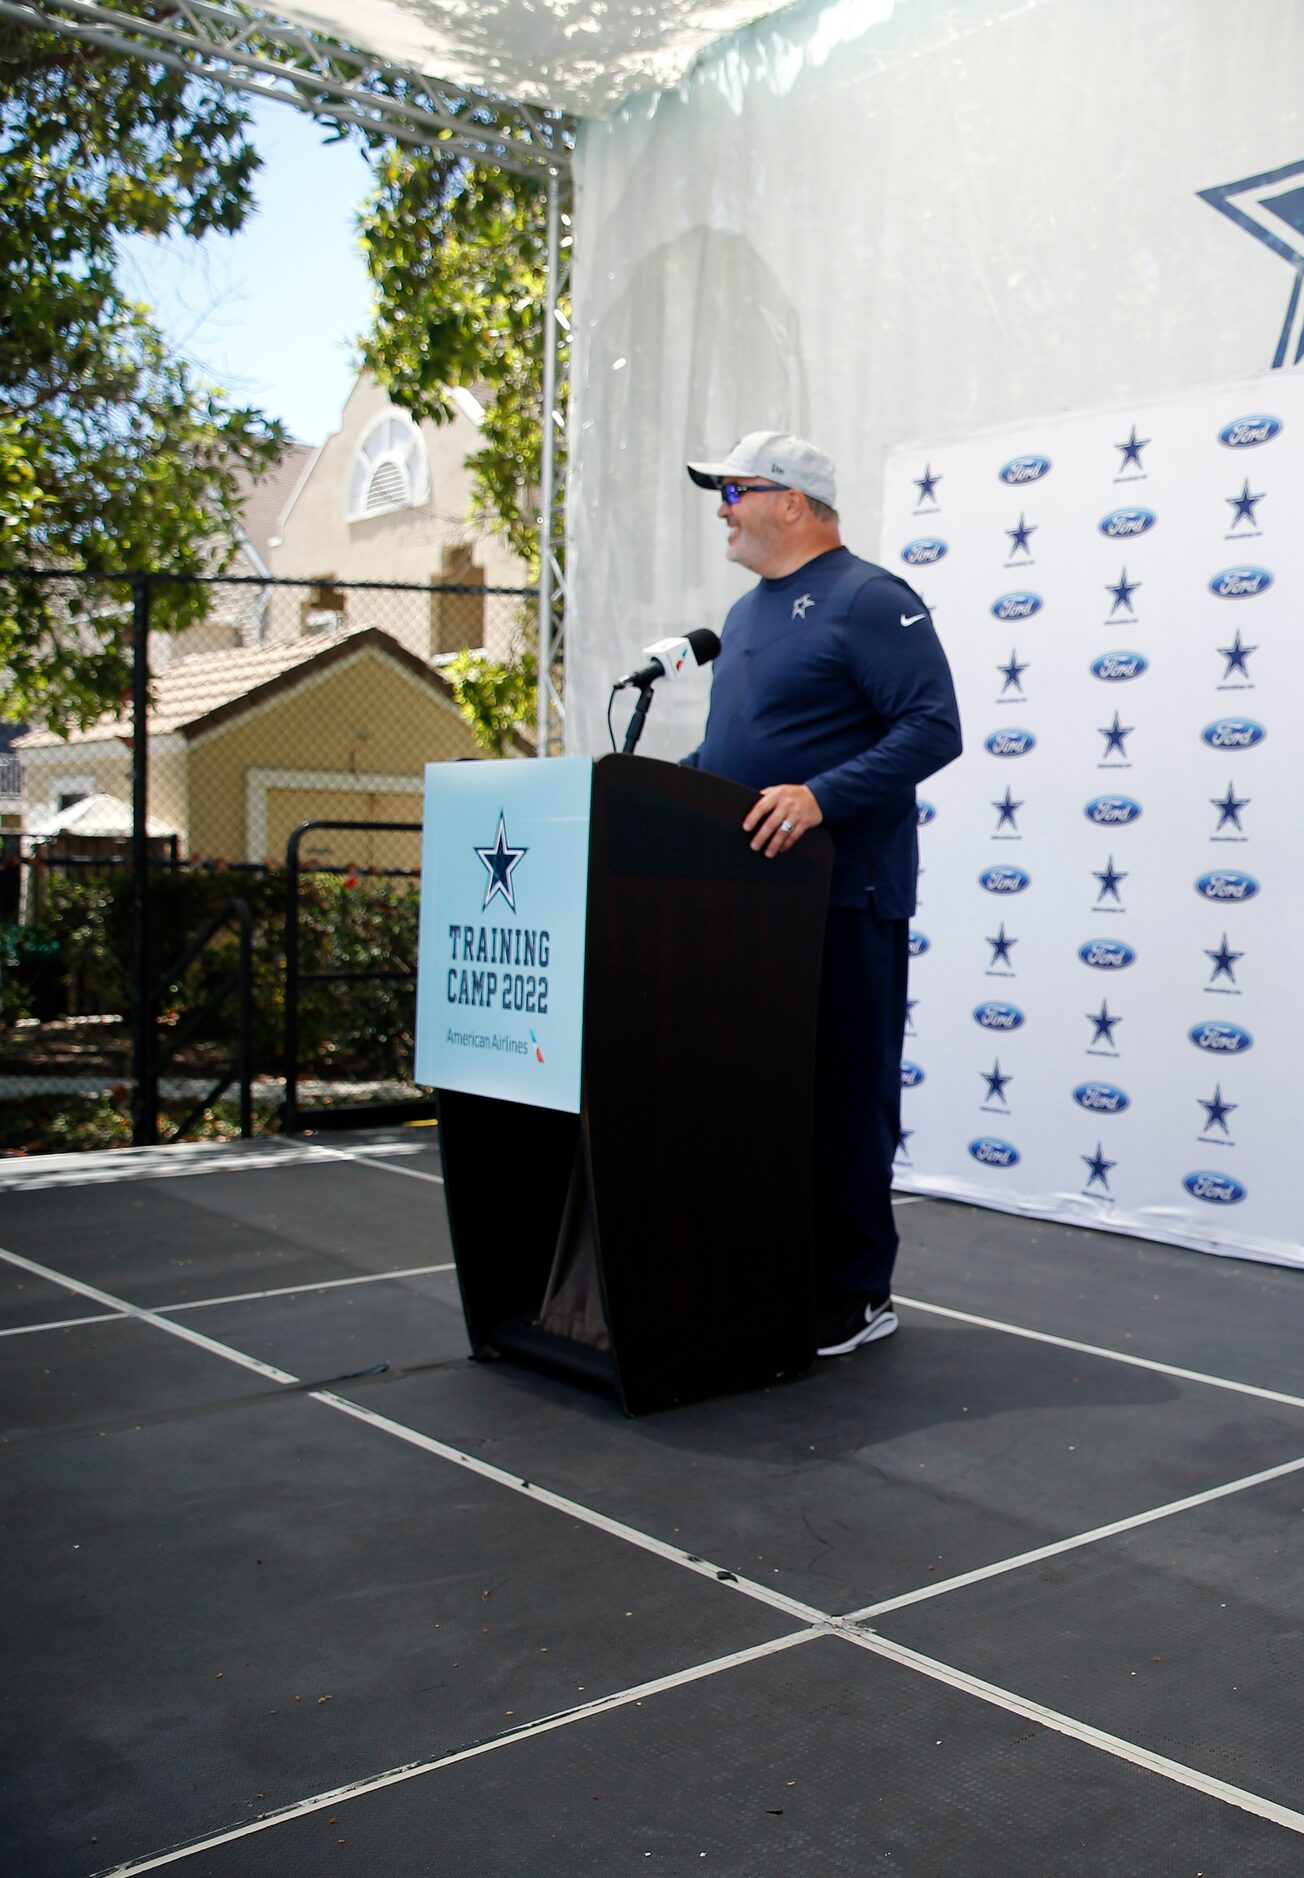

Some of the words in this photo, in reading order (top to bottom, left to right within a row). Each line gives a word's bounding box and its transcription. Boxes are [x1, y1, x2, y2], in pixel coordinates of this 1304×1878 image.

[1228, 418, 1273, 447] Ford
[1007, 459, 1043, 482] Ford
[1107, 512, 1146, 536] Ford
[908, 543, 939, 564] Ford
[1219, 571, 1261, 597] Ford
[1000, 596, 1035, 619] Ford
[1100, 655, 1138, 678] Ford
[993, 732, 1027, 754] Ford
[1211, 722, 1253, 748] Ford
[1094, 798, 1131, 823] Ford
[987, 868, 1021, 891] Ford
[1205, 873, 1248, 898] Ford
[449, 924, 550, 968] TRAINING
[1088, 943, 1126, 967] Ford
[447, 968, 498, 1008] CAMP
[502, 973, 548, 1014] 2022
[982, 1005, 1016, 1028] Ford
[447, 1028, 490, 1049] American
[491, 1033, 529, 1055] Airlines
[1199, 1025, 1243, 1051] Ford
[1083, 1086, 1120, 1112] Ford
[977, 1140, 1011, 1164] Ford
[1194, 1174, 1237, 1202] Ford
